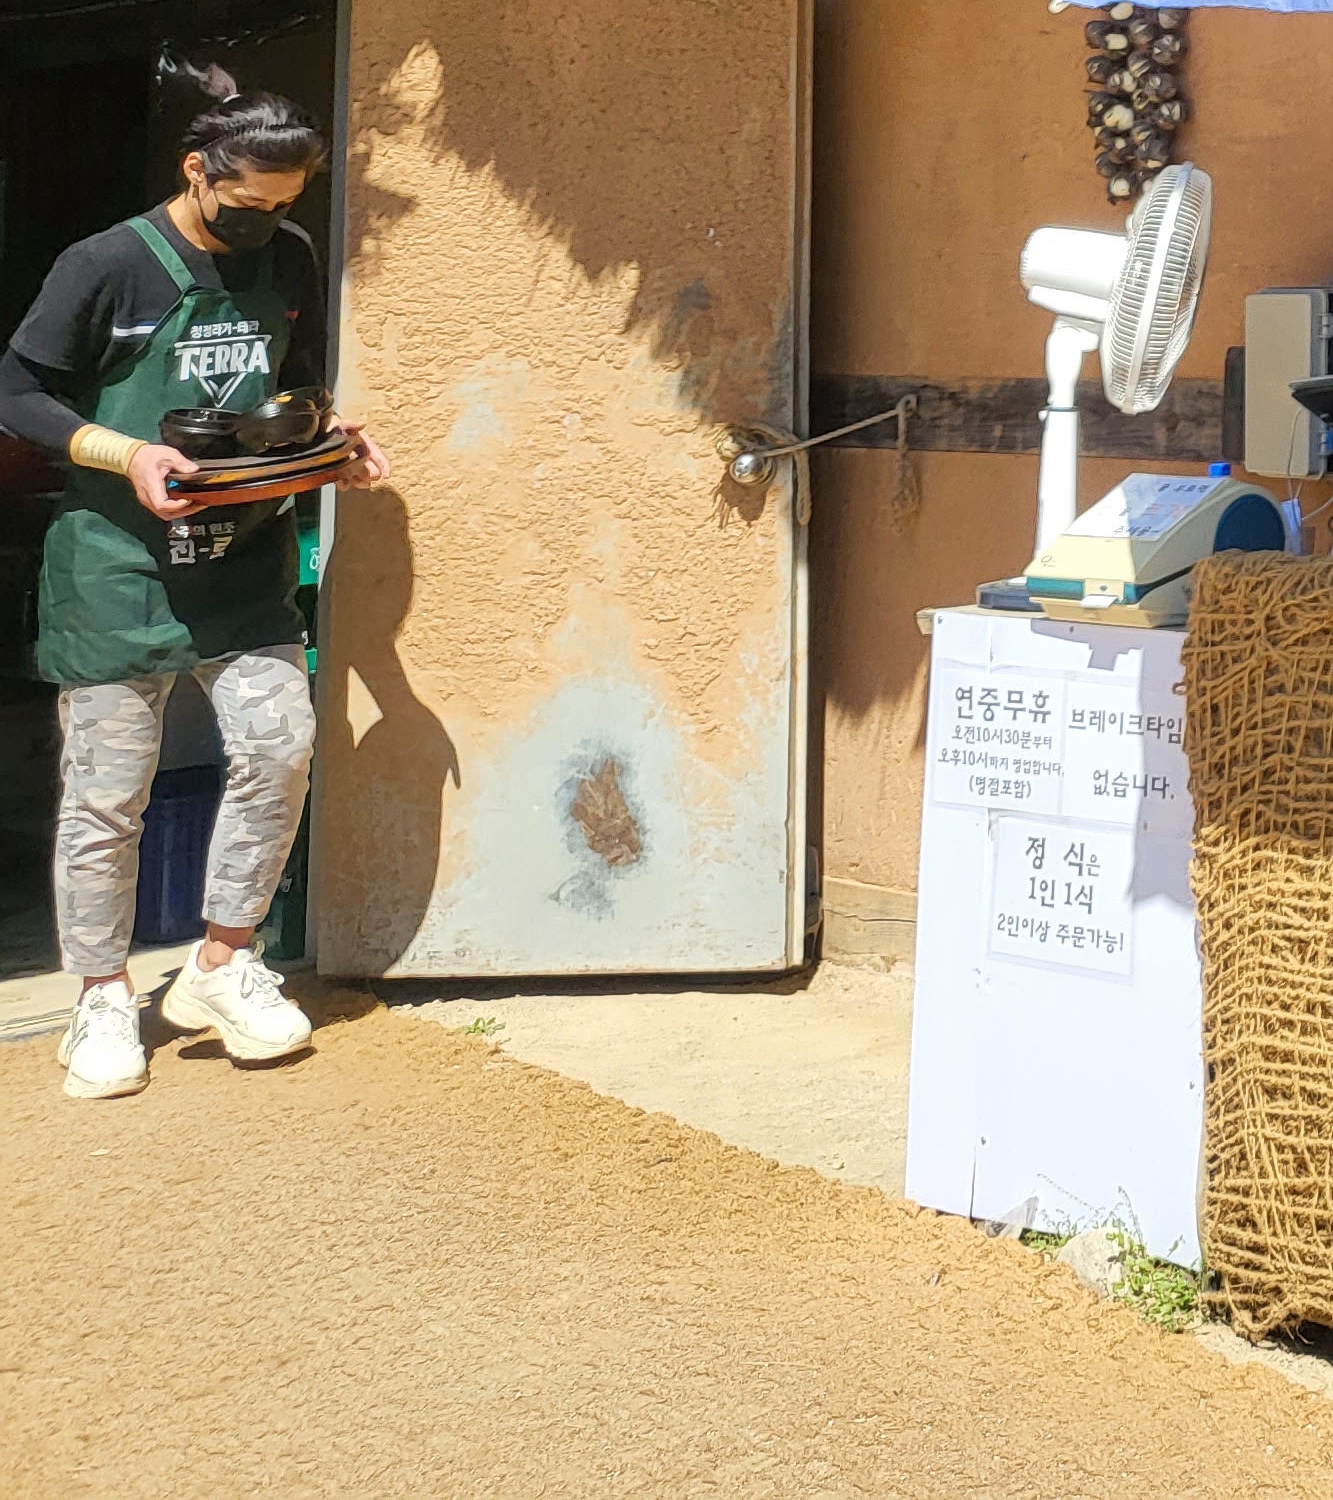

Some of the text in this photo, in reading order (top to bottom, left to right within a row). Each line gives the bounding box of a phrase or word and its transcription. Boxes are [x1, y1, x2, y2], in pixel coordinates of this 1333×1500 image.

[174, 341, 271, 382] TERRA
[955, 685, 1052, 724] 연중무휴
[951, 724, 1053, 750] 오전10시30분부터
[1068, 708, 1183, 744] 브레이크타임
[937, 747, 1009, 772] 오후10시까지
[968, 774, 1032, 799] (명절포함)
[1093, 769, 1175, 800] 없습니다.
[1028, 876, 1094, 915] 1인 1식
[997, 912, 1125, 954] 2인이상 주문가능!
